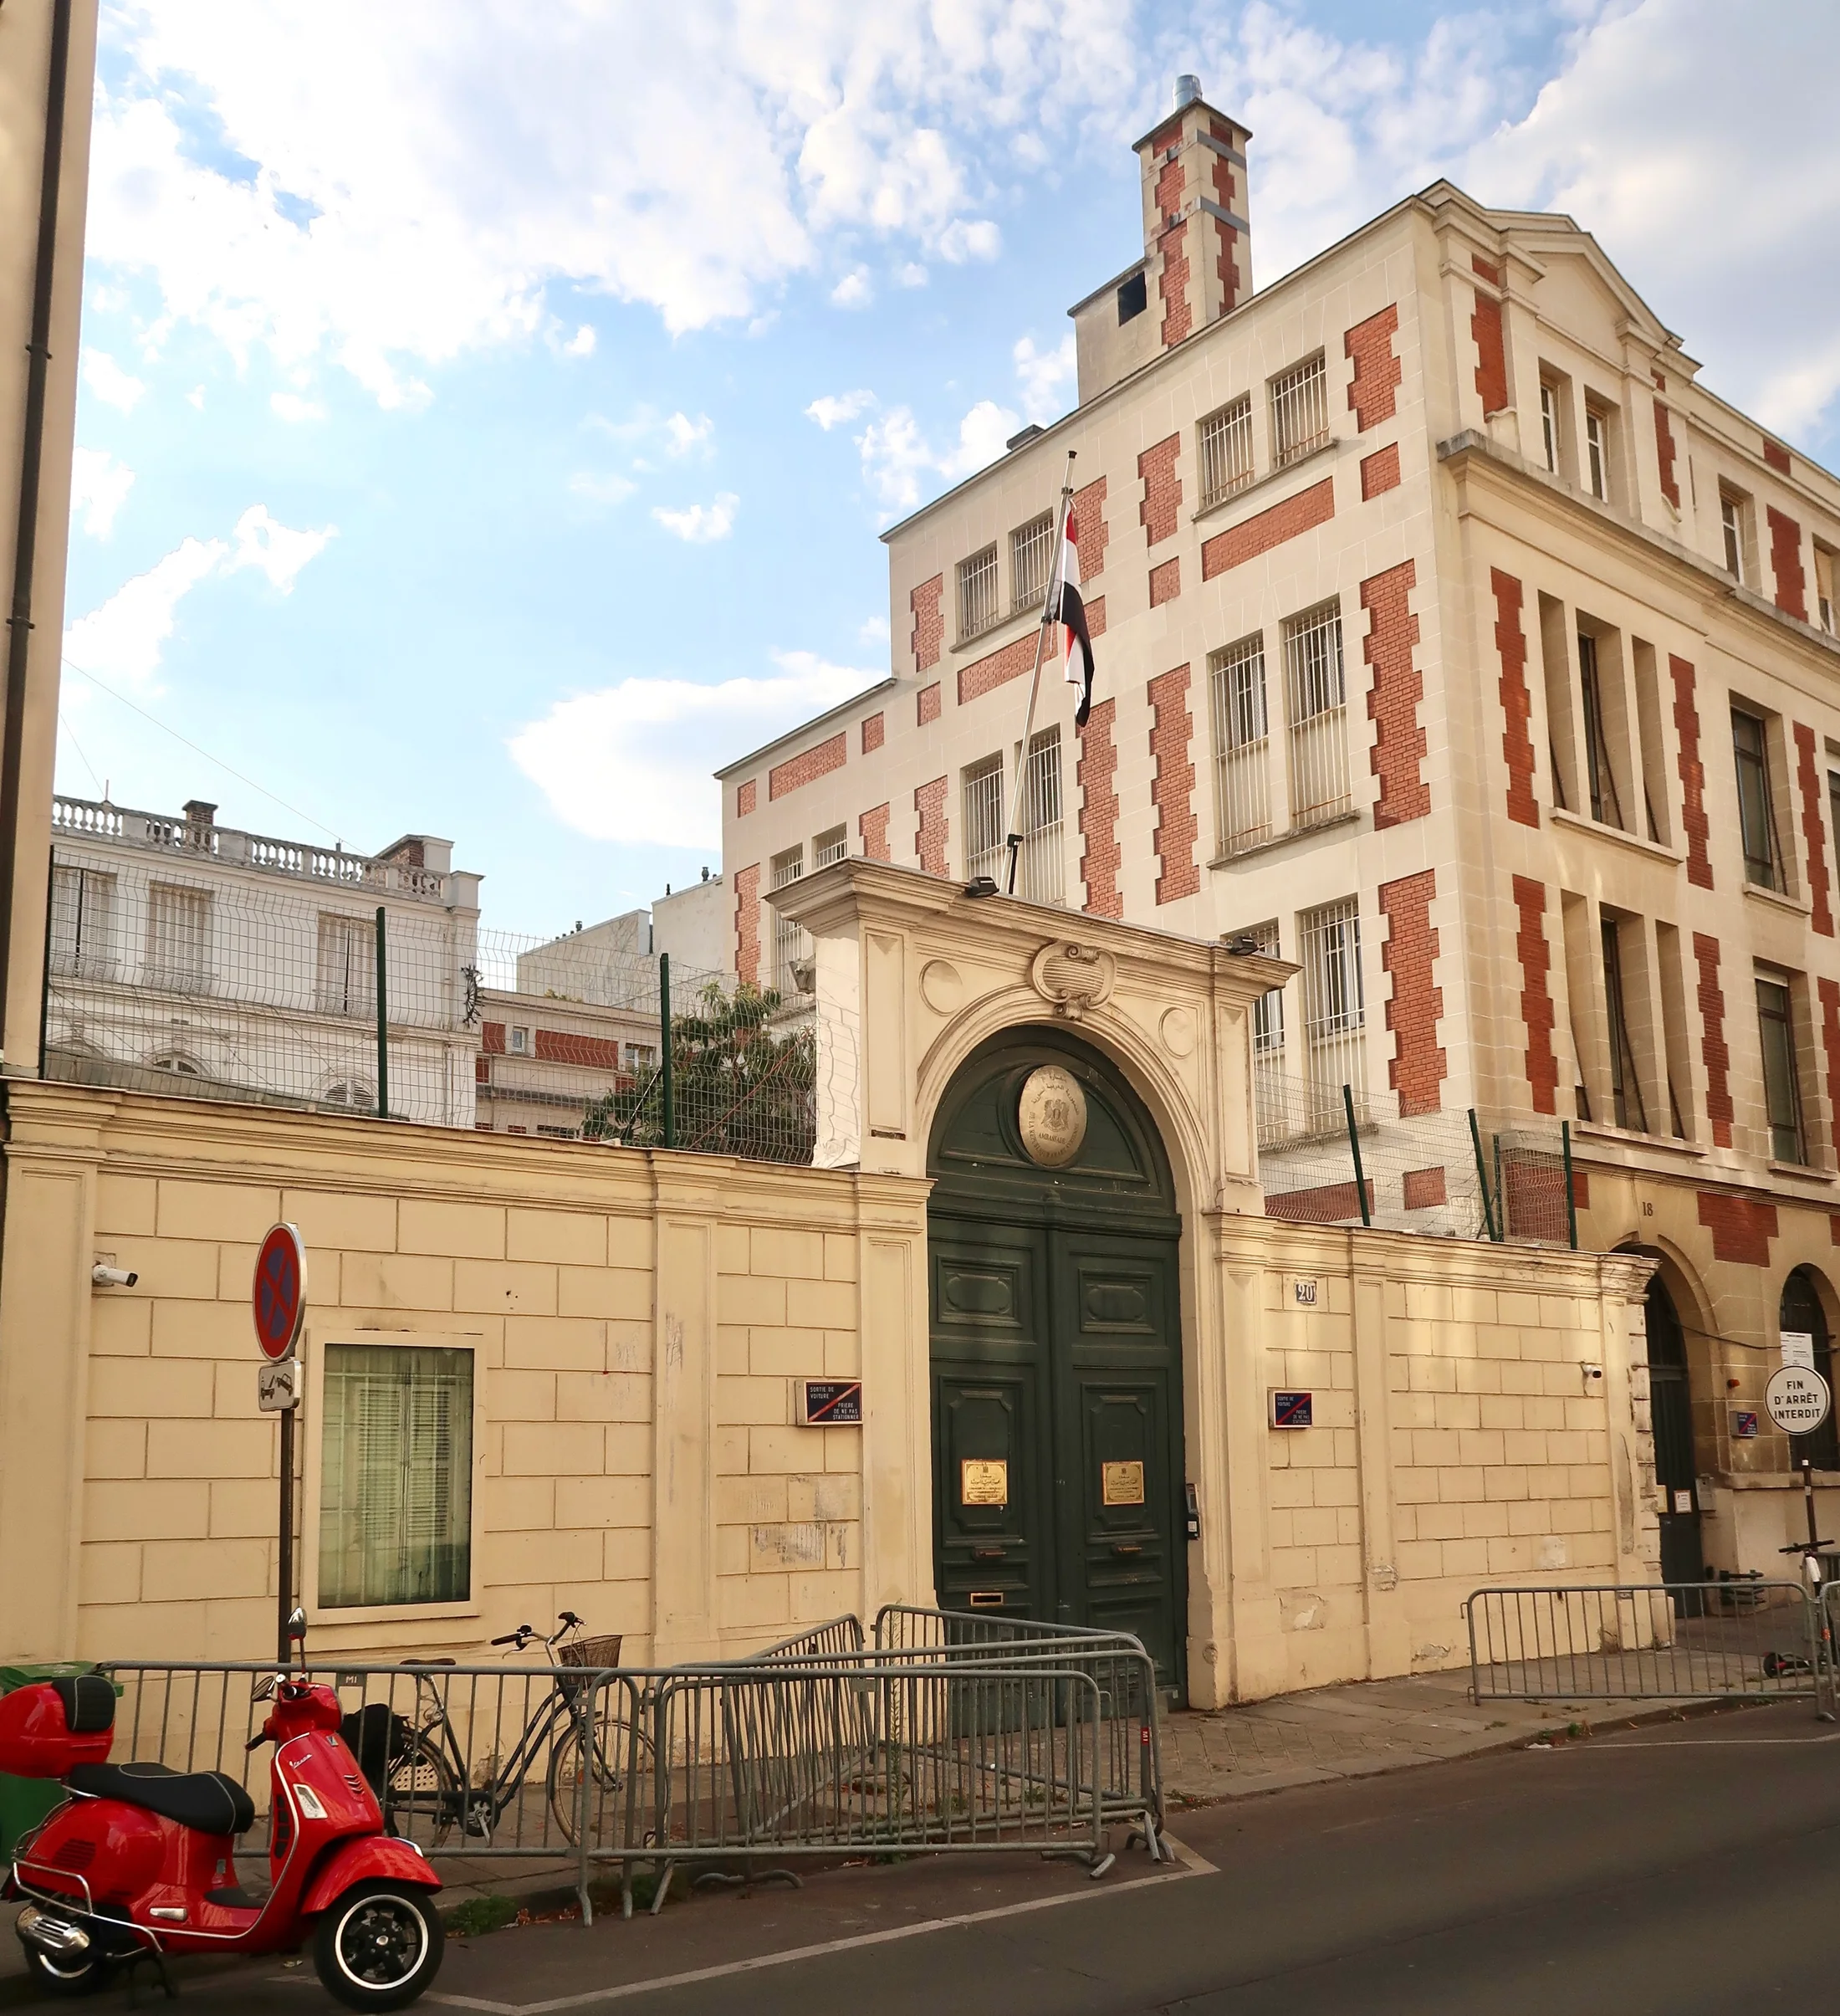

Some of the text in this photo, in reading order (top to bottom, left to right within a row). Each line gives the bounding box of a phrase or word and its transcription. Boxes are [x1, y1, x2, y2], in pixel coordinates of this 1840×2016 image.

[1642, 1201, 1653, 1216] 18
[1297, 1284, 1314, 1301] 20
[1786, 1380, 1804, 1389] FIN
[1774, 1409, 1821, 1420] INTERDIT
[345, 1676, 357, 1684] MI
